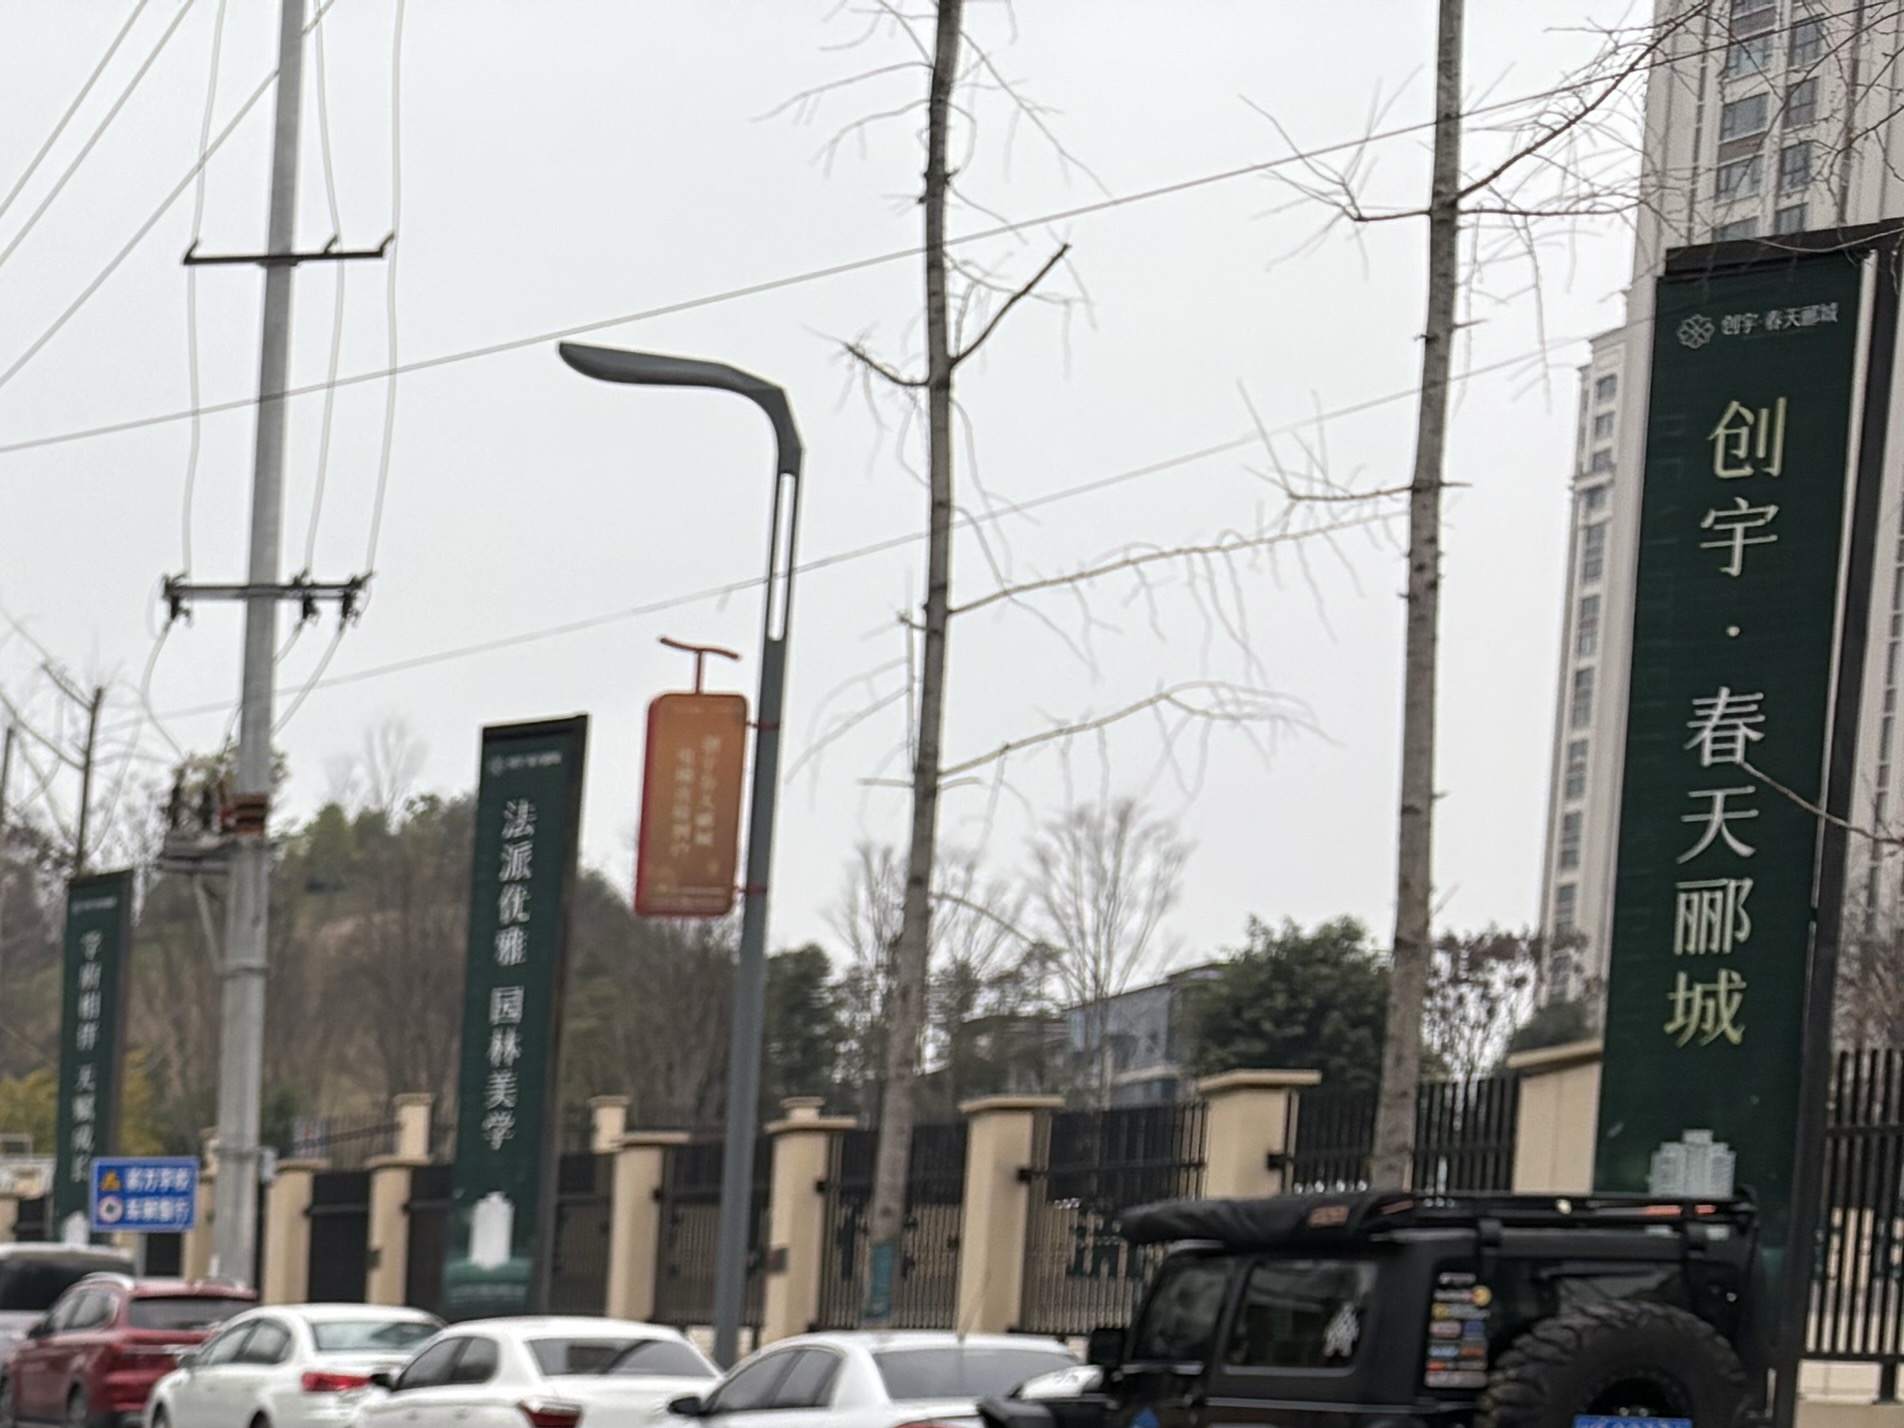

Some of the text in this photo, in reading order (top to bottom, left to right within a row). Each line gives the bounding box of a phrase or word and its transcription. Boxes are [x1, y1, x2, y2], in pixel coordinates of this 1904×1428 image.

[494, 798, 537, 966] 法派优雅
[482, 985, 525, 1150] 园林美学
